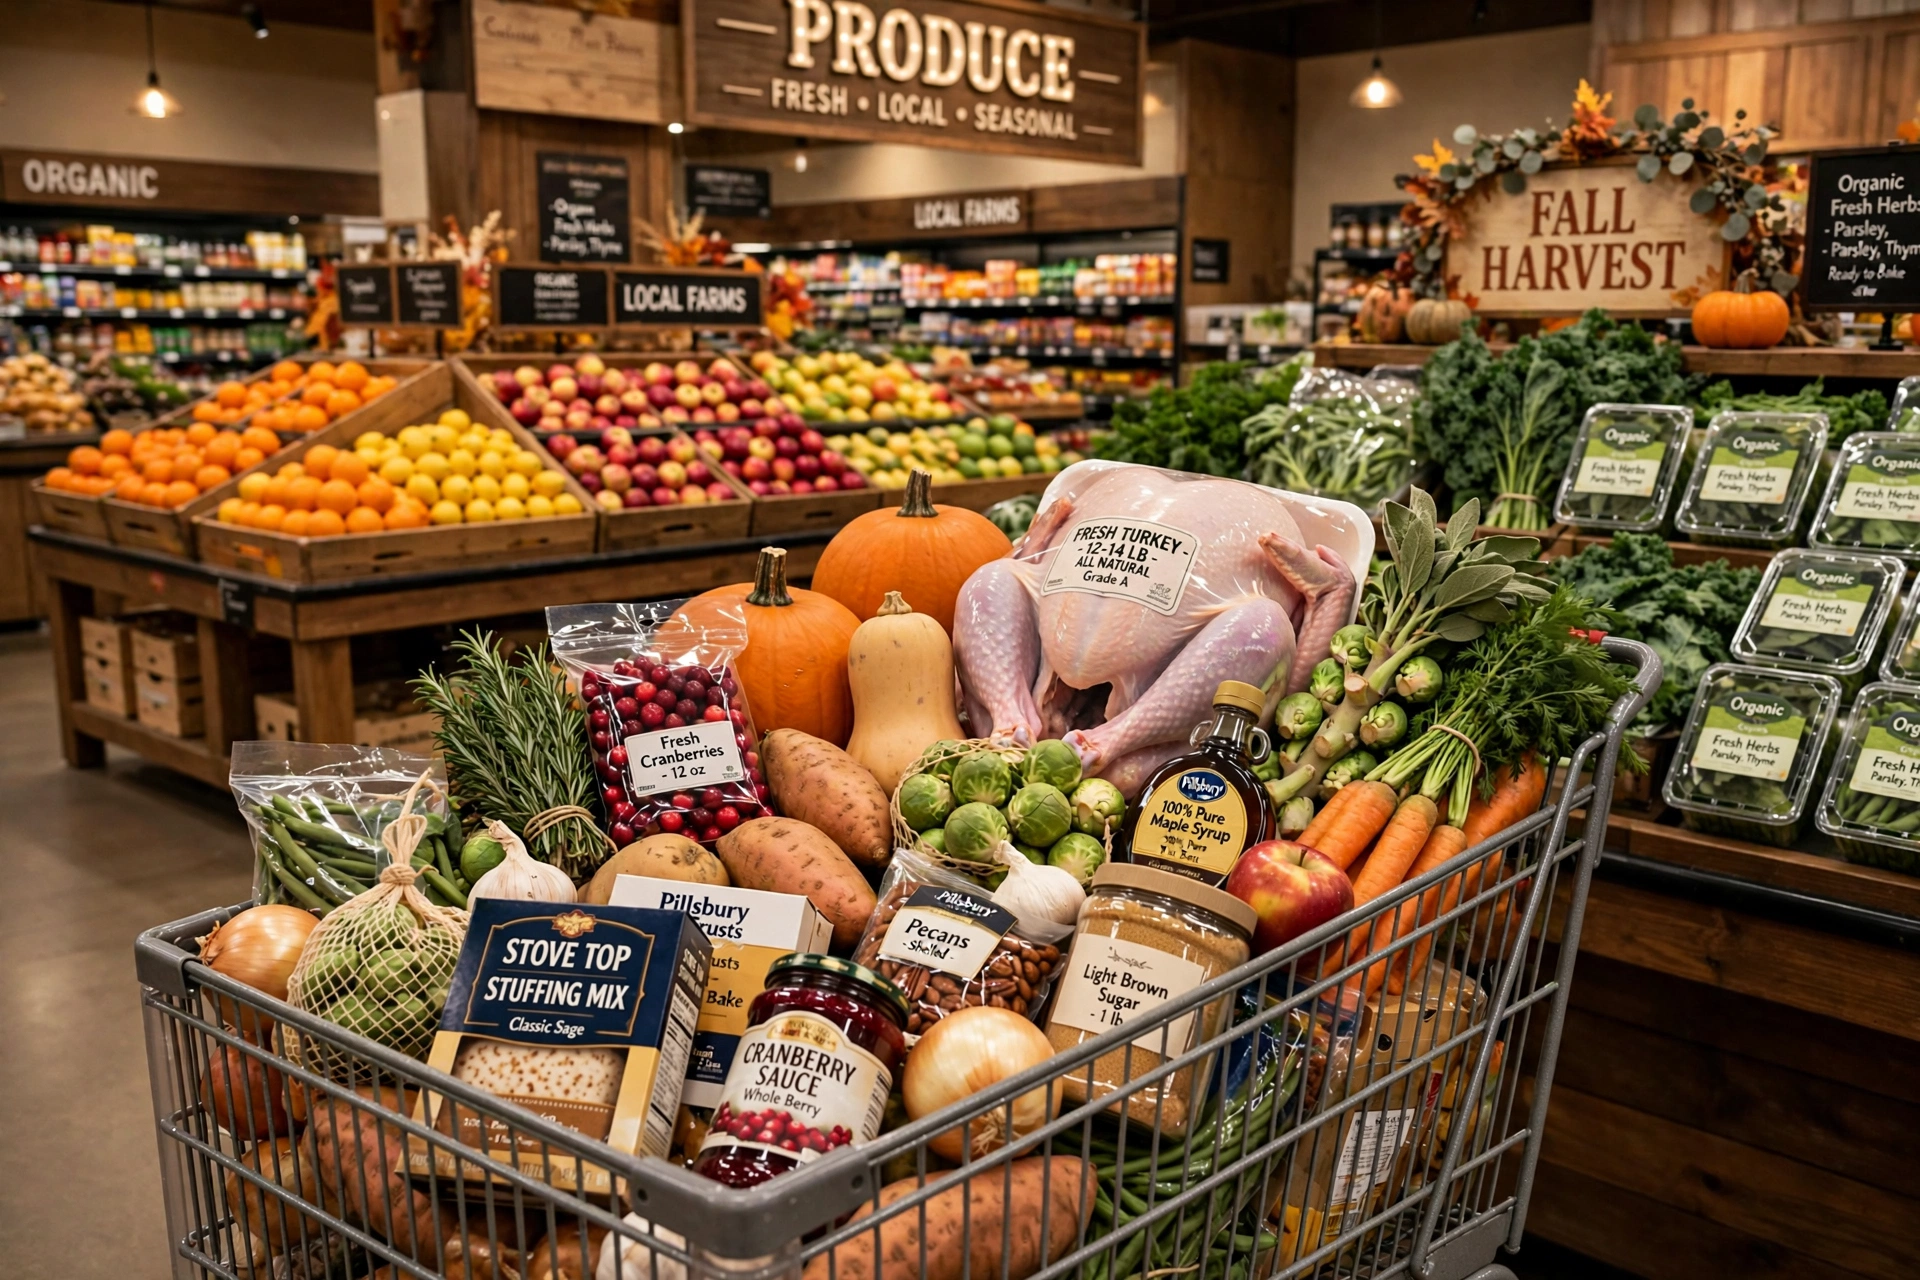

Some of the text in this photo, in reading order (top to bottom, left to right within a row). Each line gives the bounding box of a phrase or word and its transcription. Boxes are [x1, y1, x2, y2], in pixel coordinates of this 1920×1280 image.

[788, 0, 1076, 102] PRODUCE
[771, 78, 1078, 140] FRESH LOCAL SEASONAL
[22, 158, 160, 199] ORGANIC
[1838, 172, 1905, 197] Organic
[914, 200, 963, 229] LOCAL
[1529, 186, 1636, 237] FALL
[1831, 197, 1873, 216] Fresh
[1834, 219, 1889, 240] Parsley,
[1831, 240, 1881, 261] Parsley,
[1884, 240, 1920, 261] Thym
[1481, 240, 1686, 291] HARVEST
[1828, 265, 1860, 284] Ready
[1863, 268, 1876, 280] to
[623, 283, 748, 314] LOCAL FARMS
[1604, 427, 1651, 446] Organic
[1732, 435, 1782, 454] Organic
[1717, 468, 1777, 483] Fresh Herbs
[1072, 525, 1119, 543] FRESH
[1121, 526, 1183, 555] TURKEY
[1086, 541, 1125, 558] 12-14
[1127, 545, 1149, 563] LB
[1074, 556, 1151, 579] ALL NATURAL
[1082, 570, 1129, 588] Grade A
[1801, 568, 1856, 586] Organic
[1782, 598, 1848, 616] Fresh Herbs
[1730, 696, 1785, 717] Organic
[1892, 716, 1920, 739] Org
[660, 731, 701, 750] Fresh
[1712, 734, 1780, 755] Fresh Herbs
[640, 745, 725, 769] Cranberries
[1747, 752, 1776, 768] Thyme
[1872, 756, 1907, 773] Fresh
[671, 765, 687, 780] 12
[689, 766, 706, 776] oz
[1161, 800, 1226, 825] 100% Pure
[1149, 813, 1191, 833] Maple
[1191, 821, 1231, 845] Syrup
[659, 891, 750, 925] Pillsbury
[691, 916, 744, 939] rusts
[904, 917, 971, 949] Pecans
[502, 937, 633, 973] STOVE TOP
[711, 956, 740, 971] usts
[1083, 963, 1169, 1000] Light Brown
[483, 975, 630, 1012] STUFFING MIX
[706, 989, 744, 1008] Bake
[1098, 986, 1141, 1011] Sugar
[508, 1016, 586, 1039] Classic Sage
[1100, 1009, 1107, 1023] 1
[1110, 1011, 1124, 1026] lb
[743, 1042, 857, 1087] CRANBERRY
[755, 1064, 822, 1098] SAUCE
[743, 1087, 822, 1120] Whole Berry
